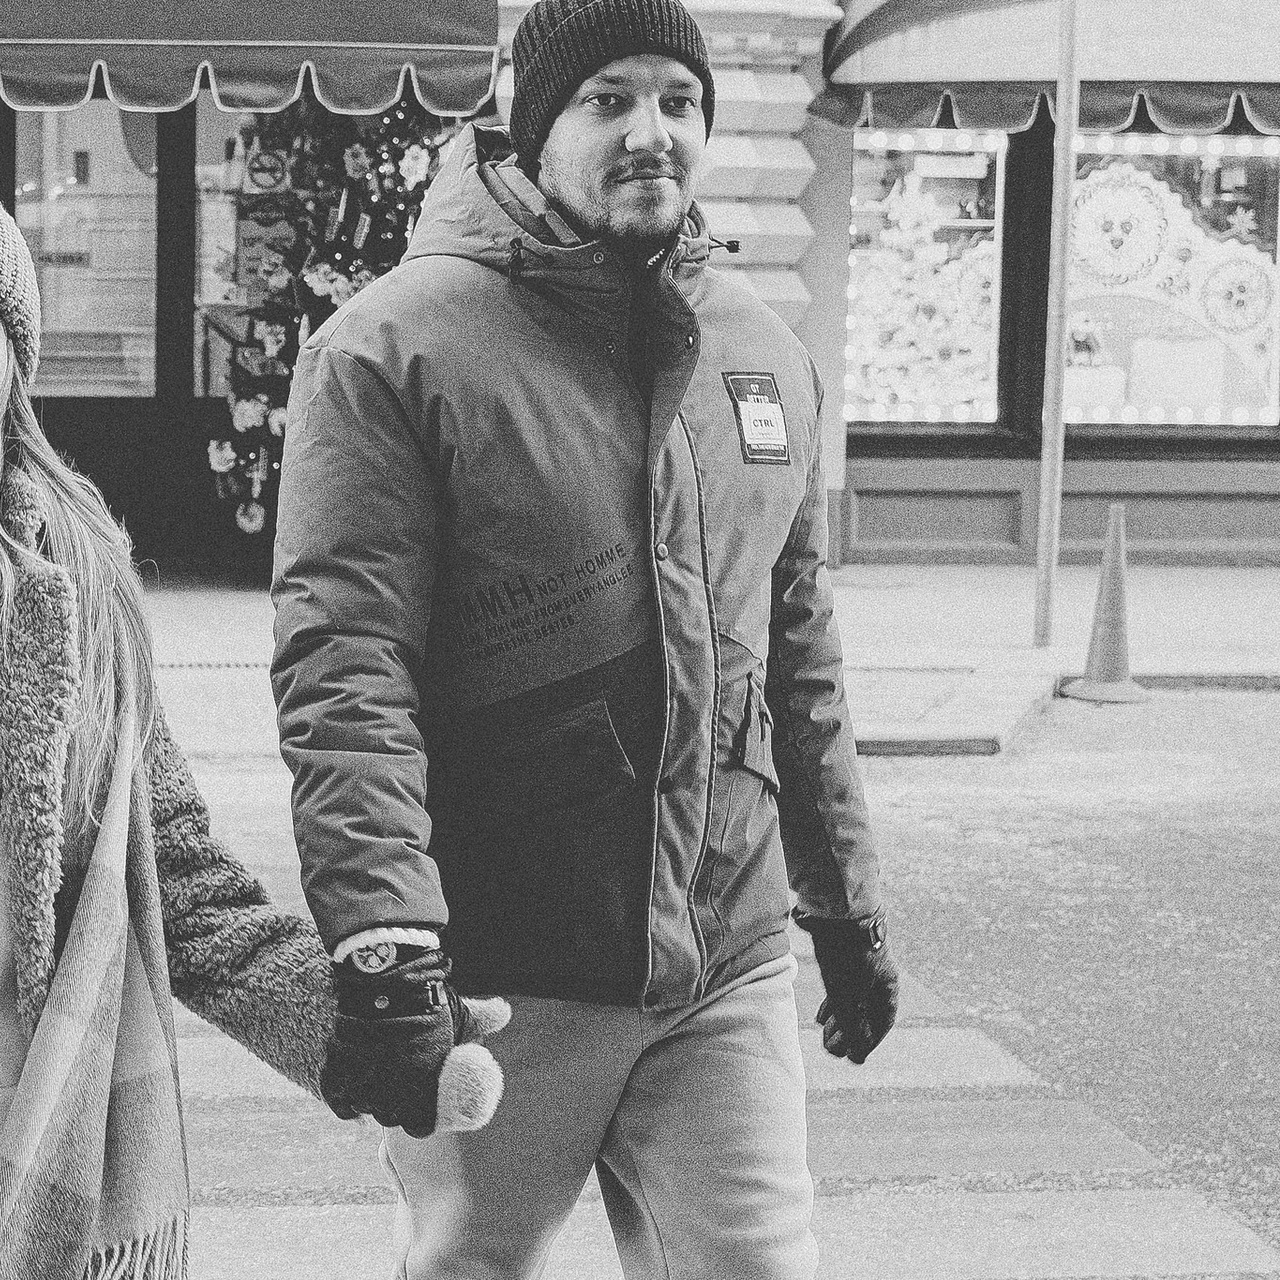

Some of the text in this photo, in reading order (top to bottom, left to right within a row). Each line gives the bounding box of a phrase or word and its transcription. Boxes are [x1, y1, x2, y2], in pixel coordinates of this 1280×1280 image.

[753, 419, 775, 428] CTRL
[536, 573, 568, 598] NOT
[574, 543, 627, 581] HOMME
